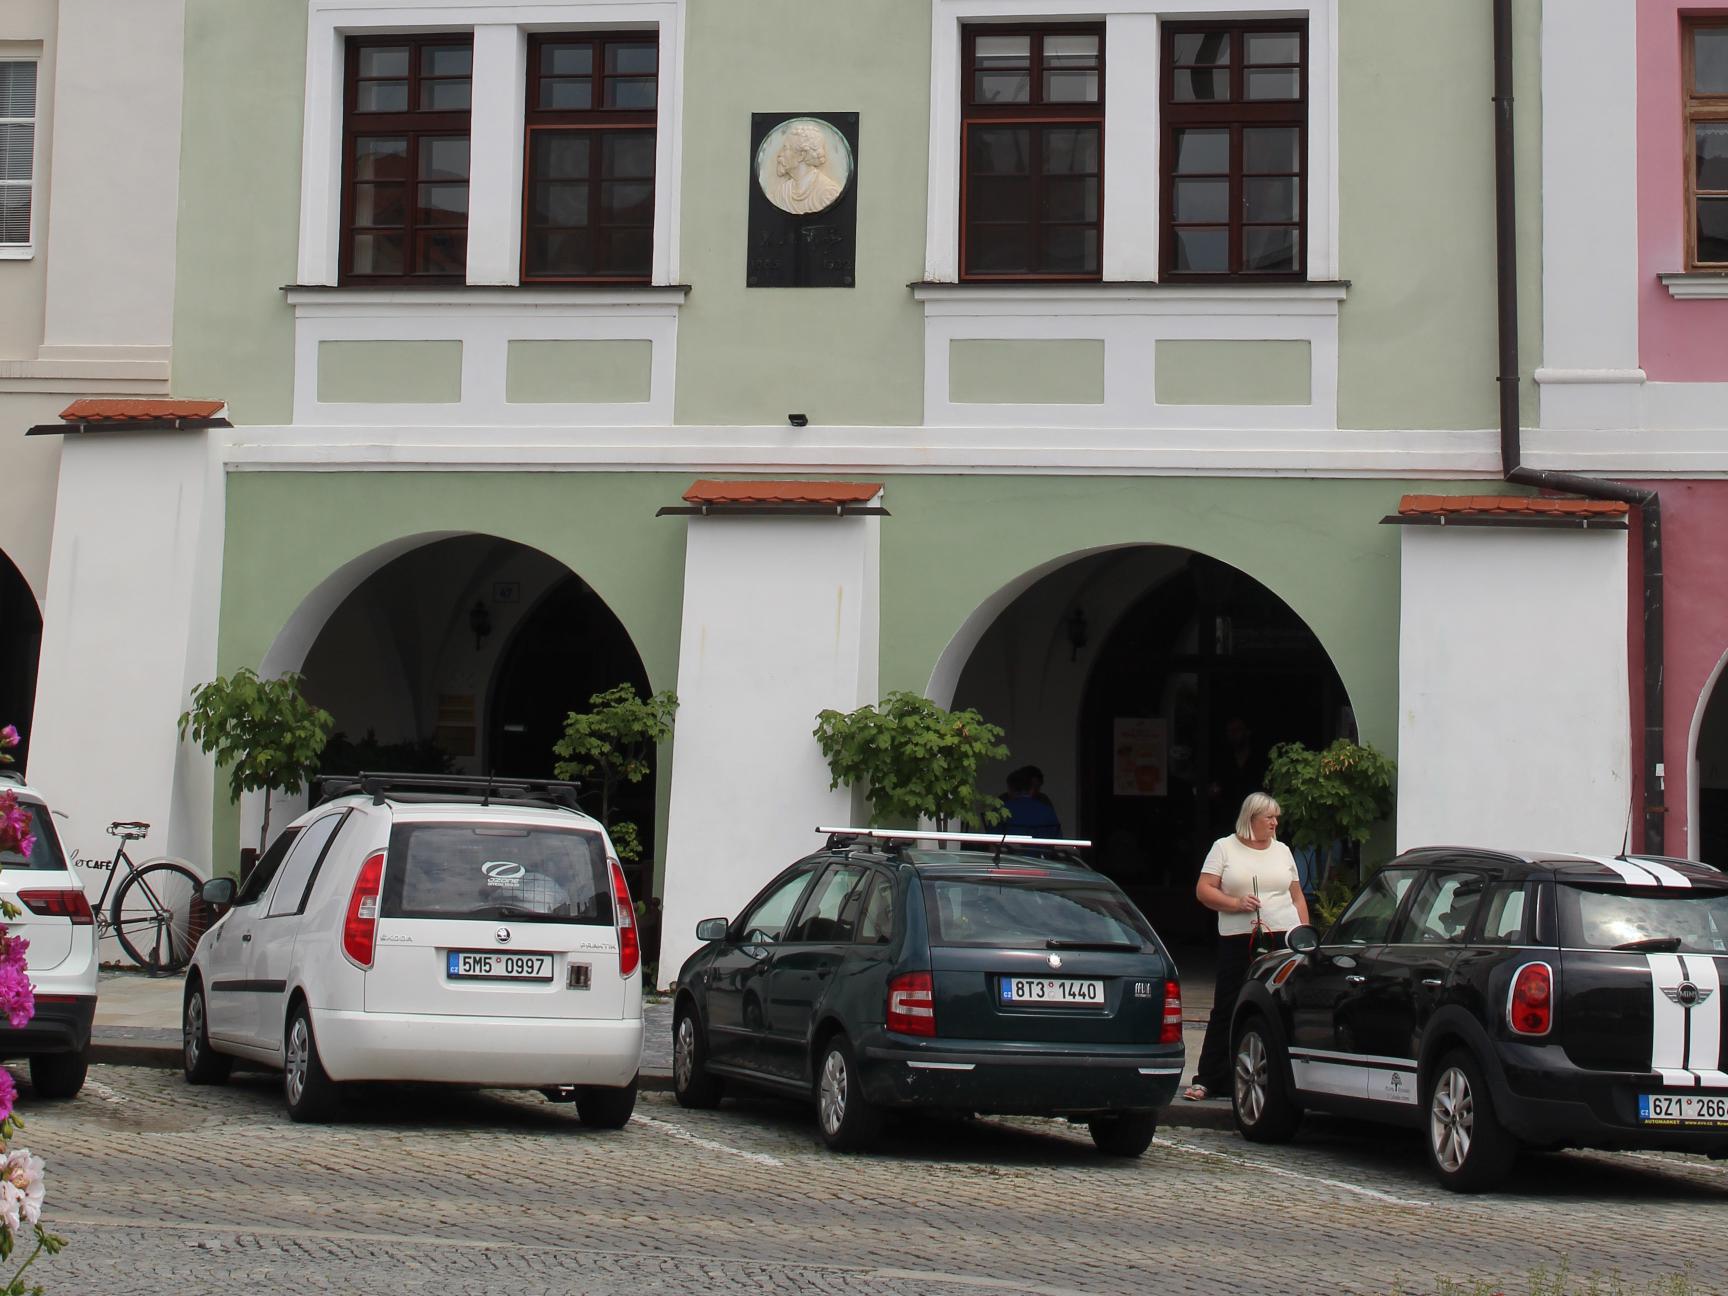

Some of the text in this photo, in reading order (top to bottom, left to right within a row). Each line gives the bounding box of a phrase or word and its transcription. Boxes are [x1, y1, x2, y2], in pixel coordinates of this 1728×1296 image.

[462, 955, 493, 974] 5M5
[504, 957, 545, 975] 0997
[1015, 980, 1045, 999] 8T3
[1058, 981, 1096, 1000] 1440
[1653, 1097, 1683, 1117] 6Z1
[1696, 1098, 1728, 1118] 266
